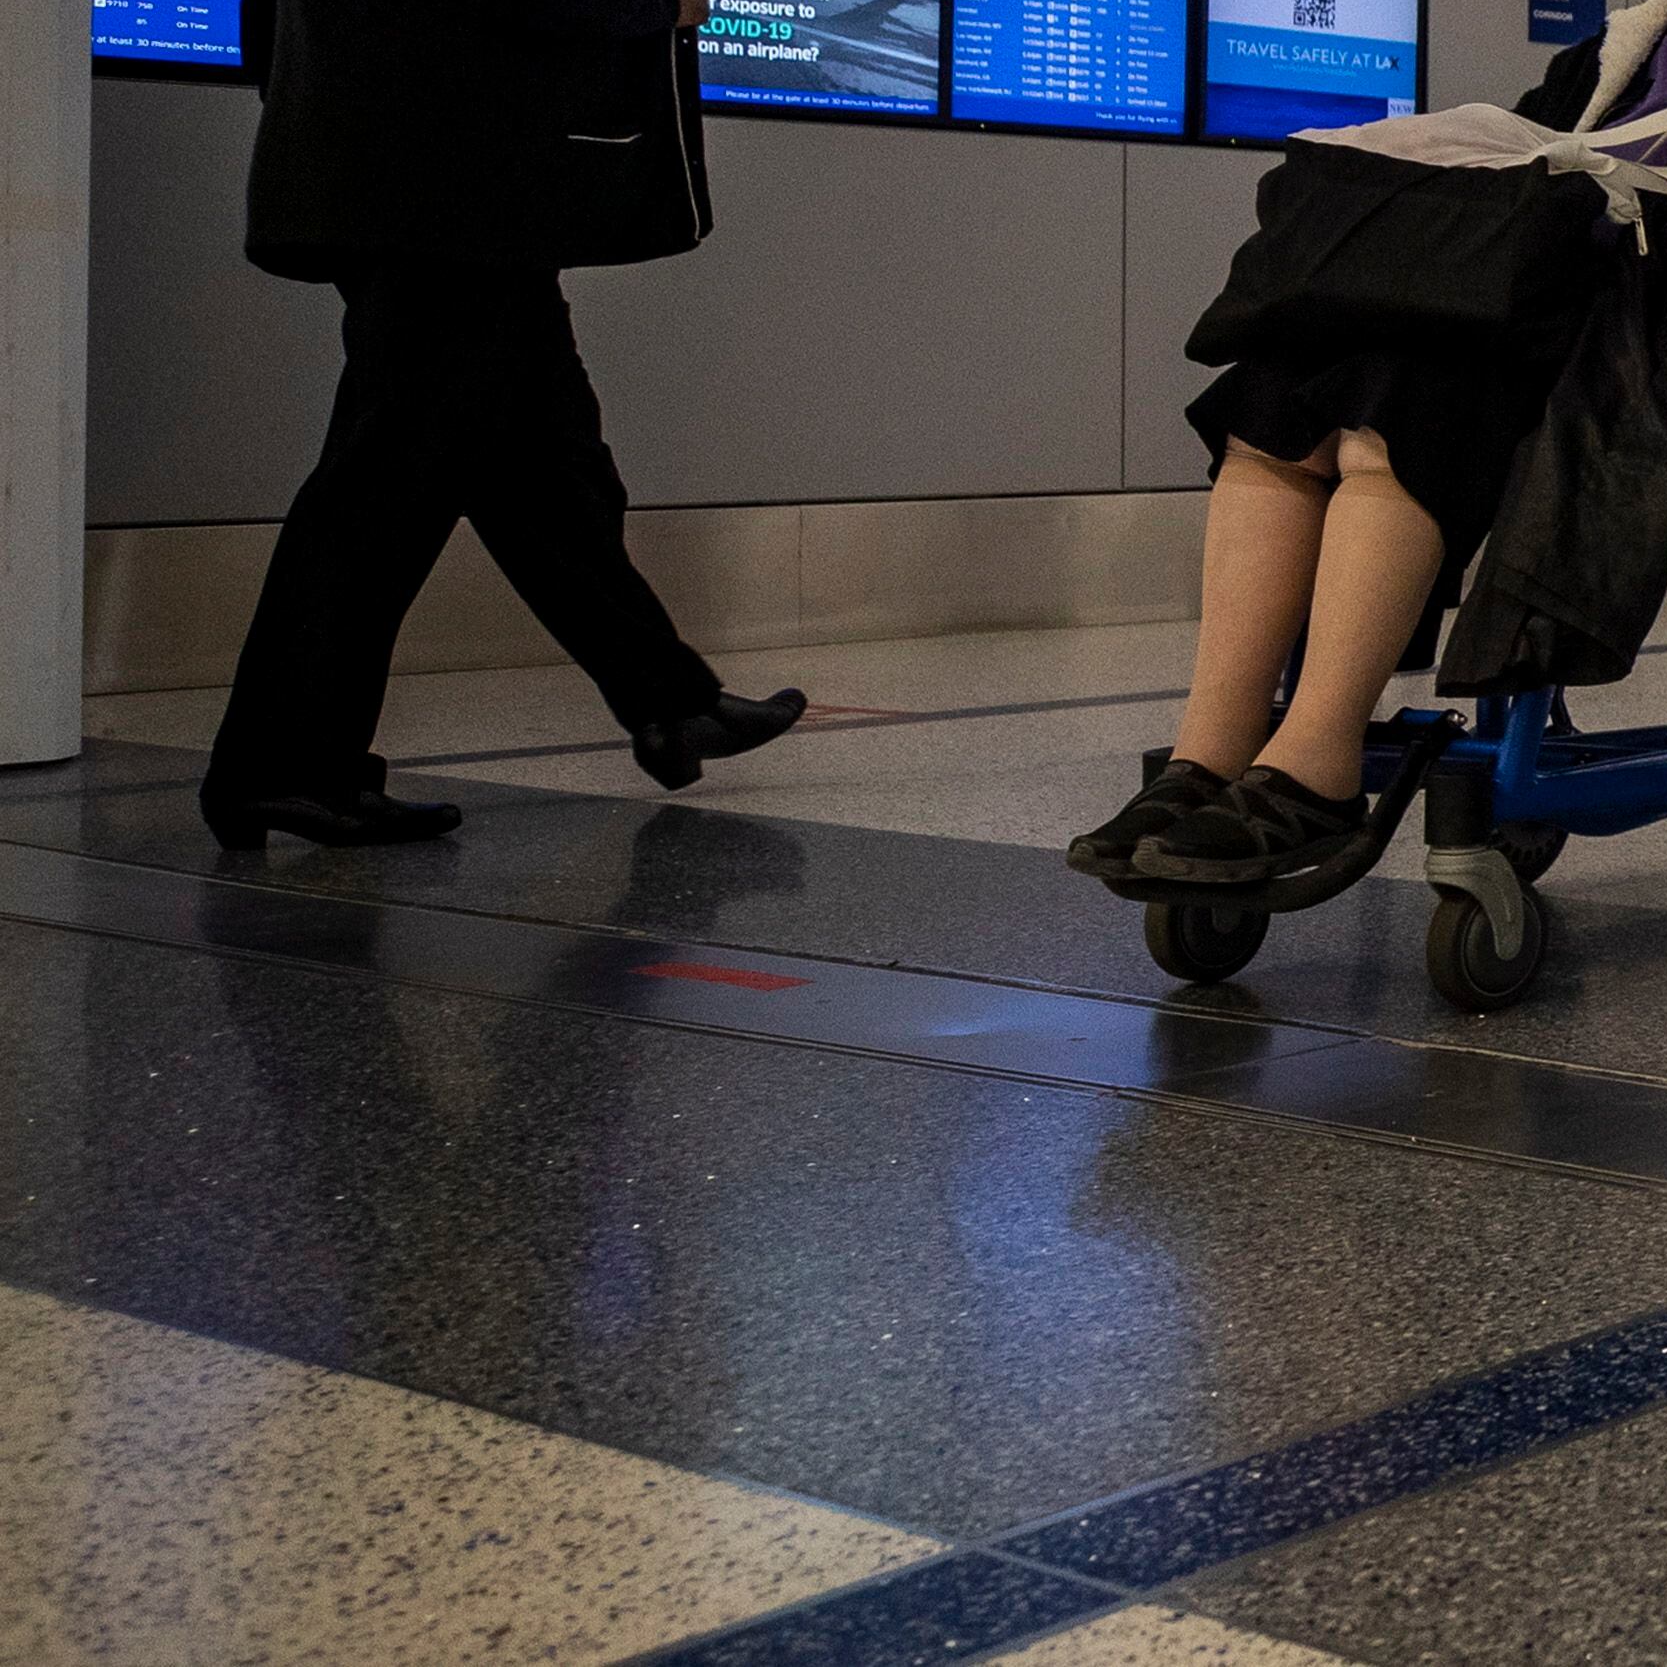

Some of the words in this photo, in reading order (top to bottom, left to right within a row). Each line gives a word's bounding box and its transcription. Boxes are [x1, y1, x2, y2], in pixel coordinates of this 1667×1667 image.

[798, 4, 816, 19] to
[1533, 9, 1574, 22] CORRIDOR
[698, 16, 793, 40] COVID-19
[96, 36, 106, 44] at
[109, 37, 132, 46] least
[136, 38, 149, 47] 30
[151, 40, 190, 50] minutes
[192, 42, 224, 53] before
[698, 40, 719, 54] on
[723, 42, 744, 56] an
[748, 42, 820, 63] airplane?
[1226, 38, 1288, 61] TRAVEL
[1292, 46, 1348, 65] SAFELY
[1352, 54, 1372, 69] AT
[1375, 55, 1400, 72] LAX
